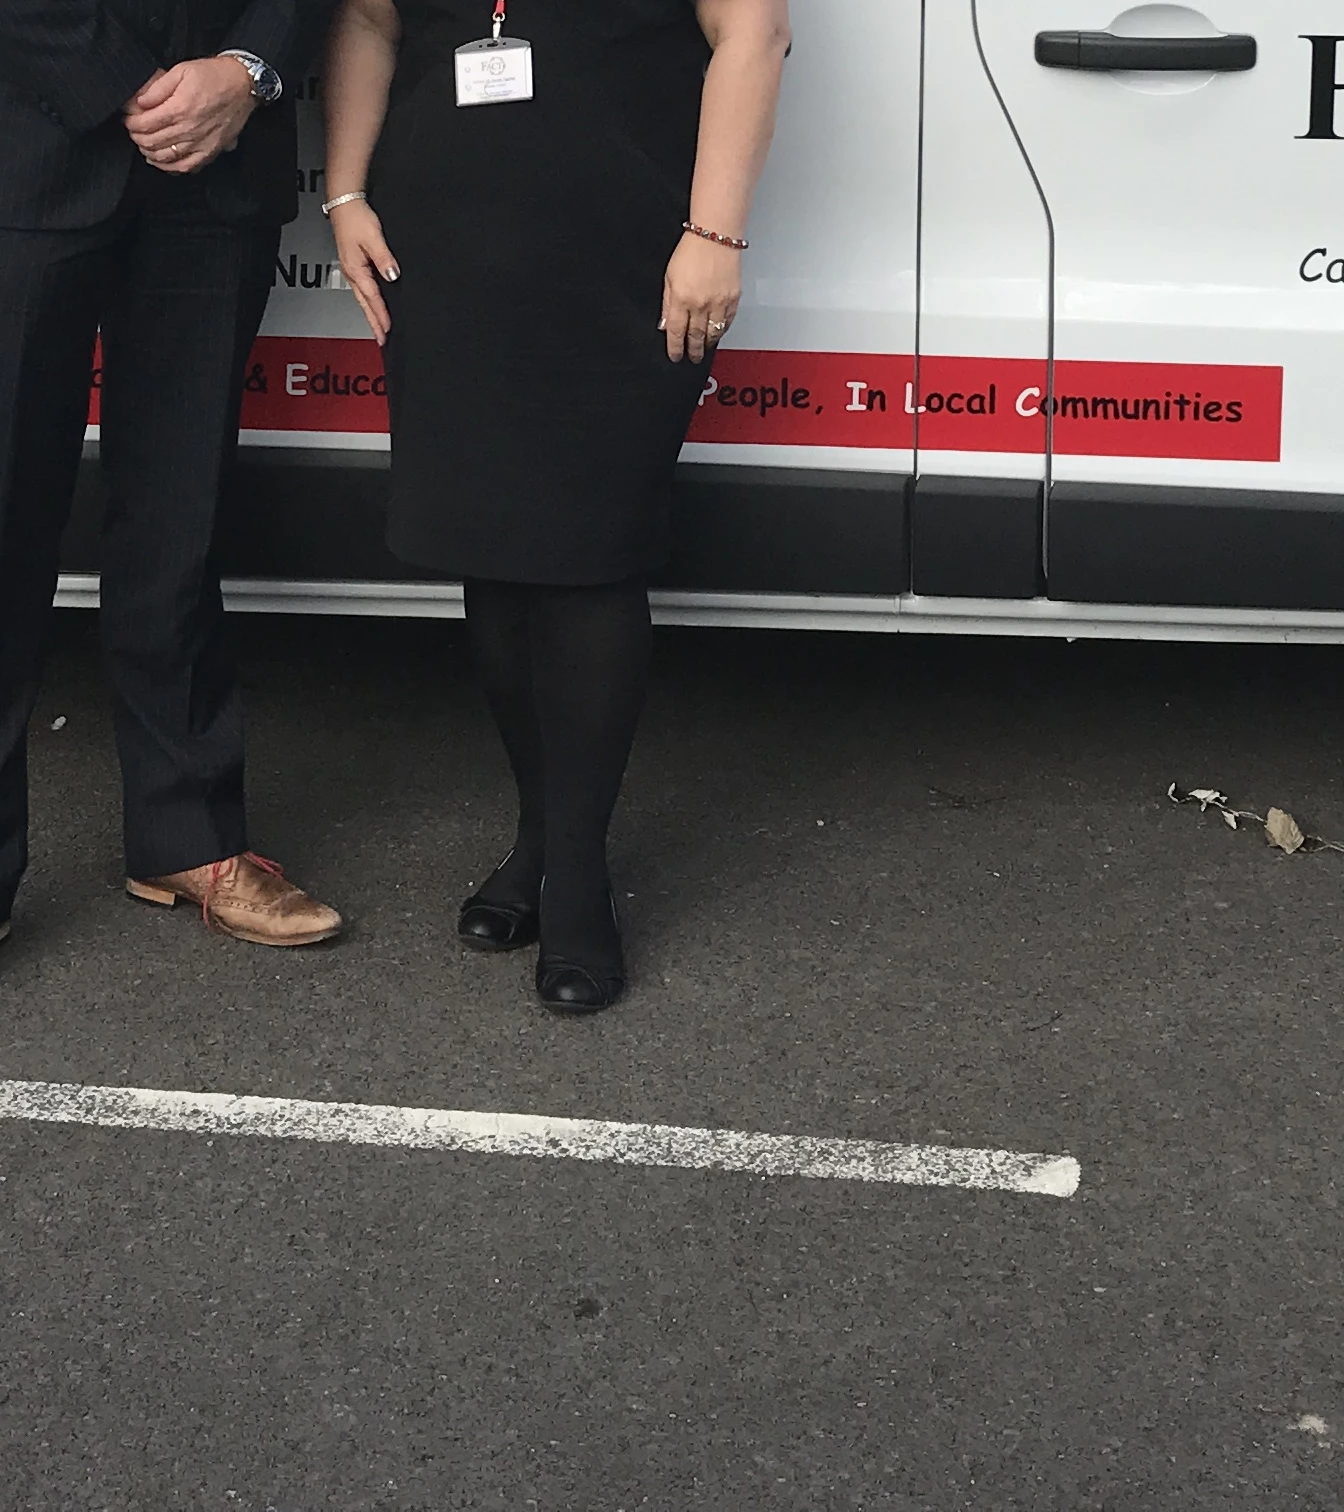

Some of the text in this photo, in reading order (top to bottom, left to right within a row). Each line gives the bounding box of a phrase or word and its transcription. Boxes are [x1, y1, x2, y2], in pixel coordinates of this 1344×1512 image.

[244, 363, 268, 394] &
[285, 362, 388, 396] Educa
[698, 375, 823, 418] People,
[844, 379, 887, 413] In
[903, 380, 996, 415] Local
[1015, 387, 1243, 424] Communities
